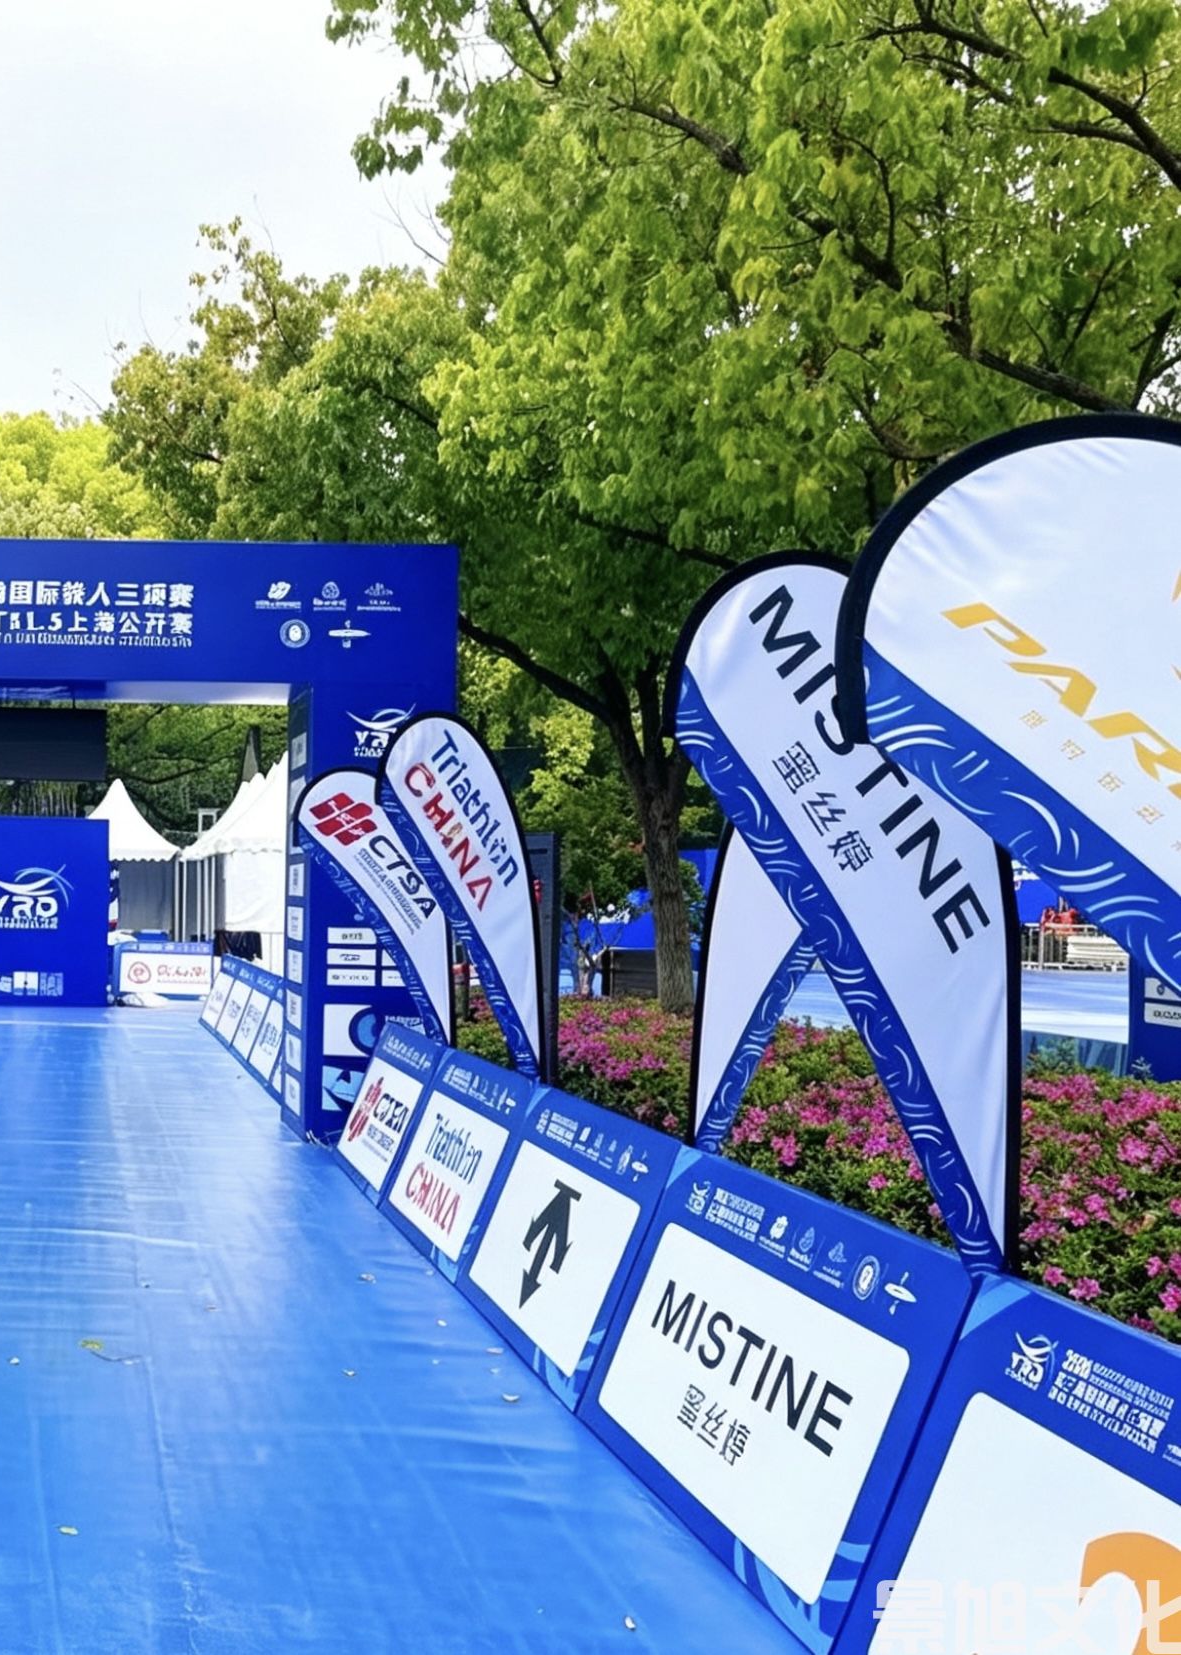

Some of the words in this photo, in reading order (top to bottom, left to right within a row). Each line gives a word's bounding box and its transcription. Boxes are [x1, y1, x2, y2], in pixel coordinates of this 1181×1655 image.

[940, 602, 1181, 800] PAR
[369, 835, 436, 918] CTSA
[431, 730, 519, 887] Triathlon
[651, 1279, 854, 1457] MISTINE
